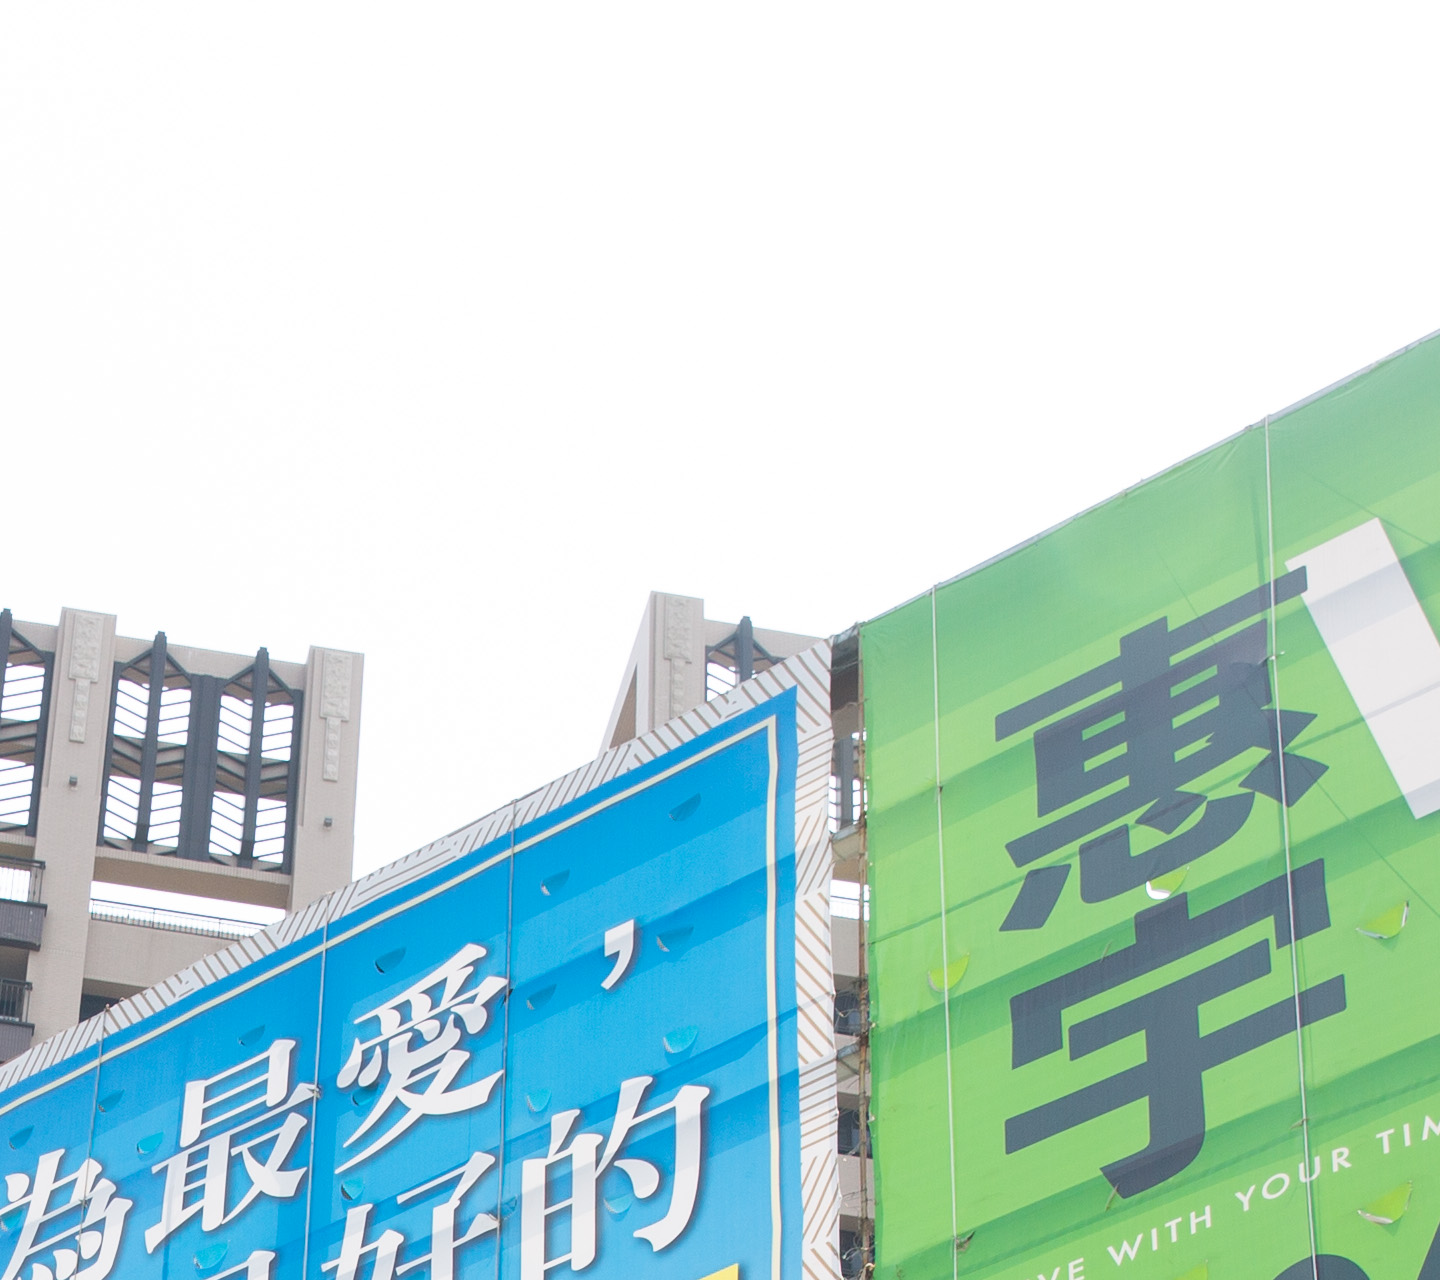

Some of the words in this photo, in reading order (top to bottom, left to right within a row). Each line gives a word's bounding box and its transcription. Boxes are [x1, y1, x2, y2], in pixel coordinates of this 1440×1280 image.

[994, 565, 1348, 1199] 惠宇
[1106, 1204, 1213, 1267] WITH
[1235, 1147, 1353, 1212] YOUR
